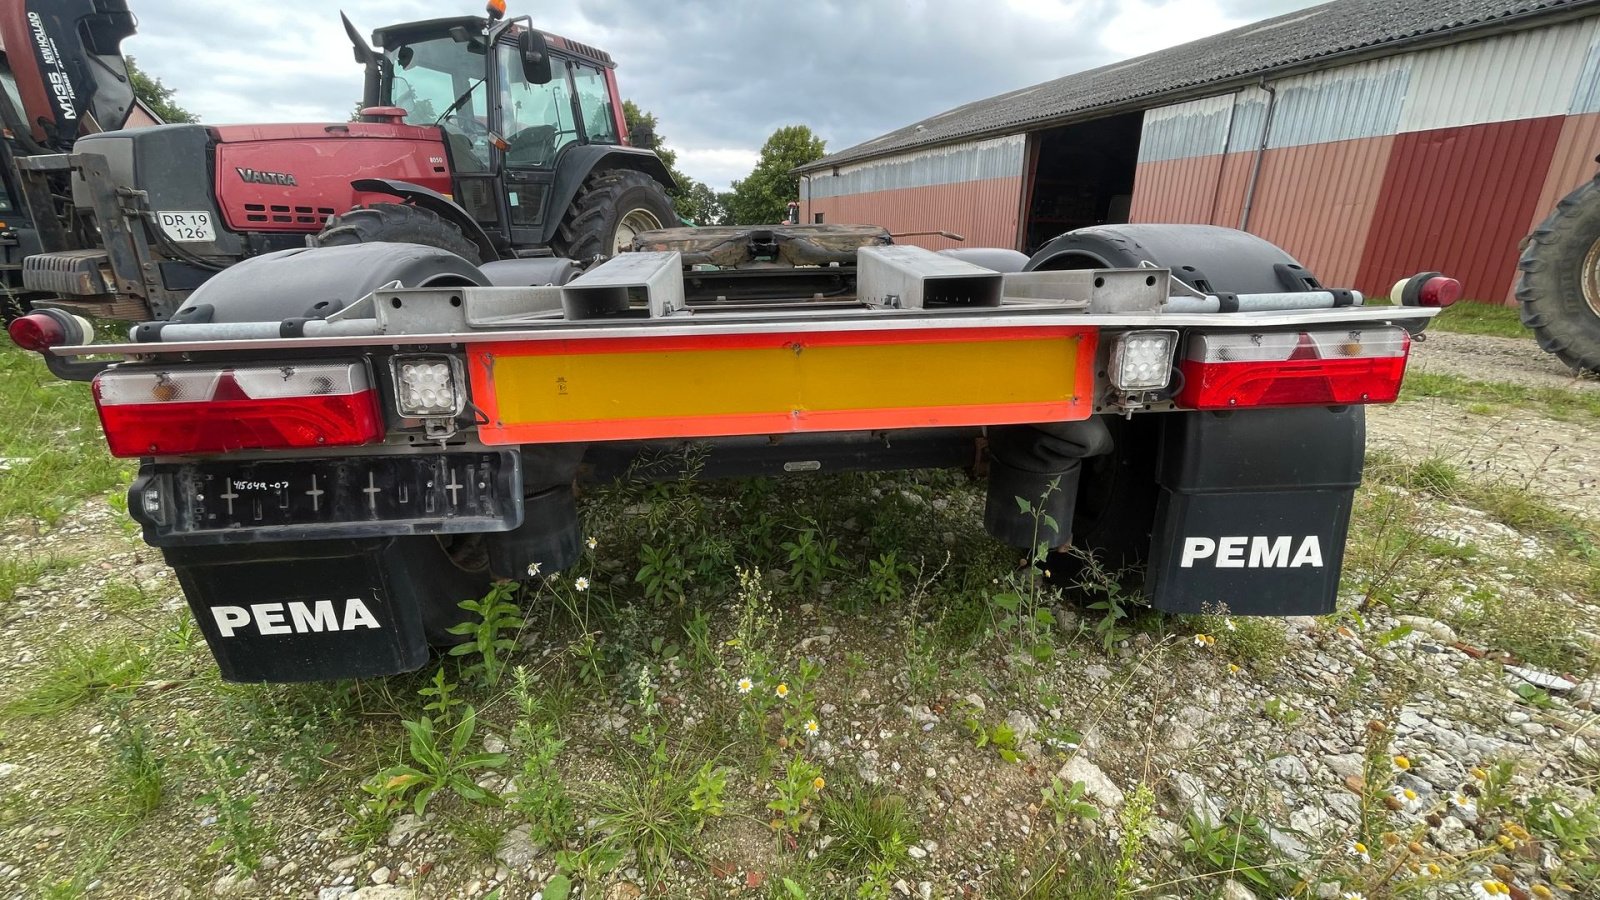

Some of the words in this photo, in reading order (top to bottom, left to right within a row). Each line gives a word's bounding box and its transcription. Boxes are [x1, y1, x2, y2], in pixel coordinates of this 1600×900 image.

[48, 72, 77, 119] M135
[236, 167, 298, 186] VALTRA
[163, 214, 186, 226] DR
[190, 214, 208, 226] 19
[176, 228, 204, 239] 126
[1180, 536, 1324, 568] PEMA
[210, 598, 381, 638] PEMA
